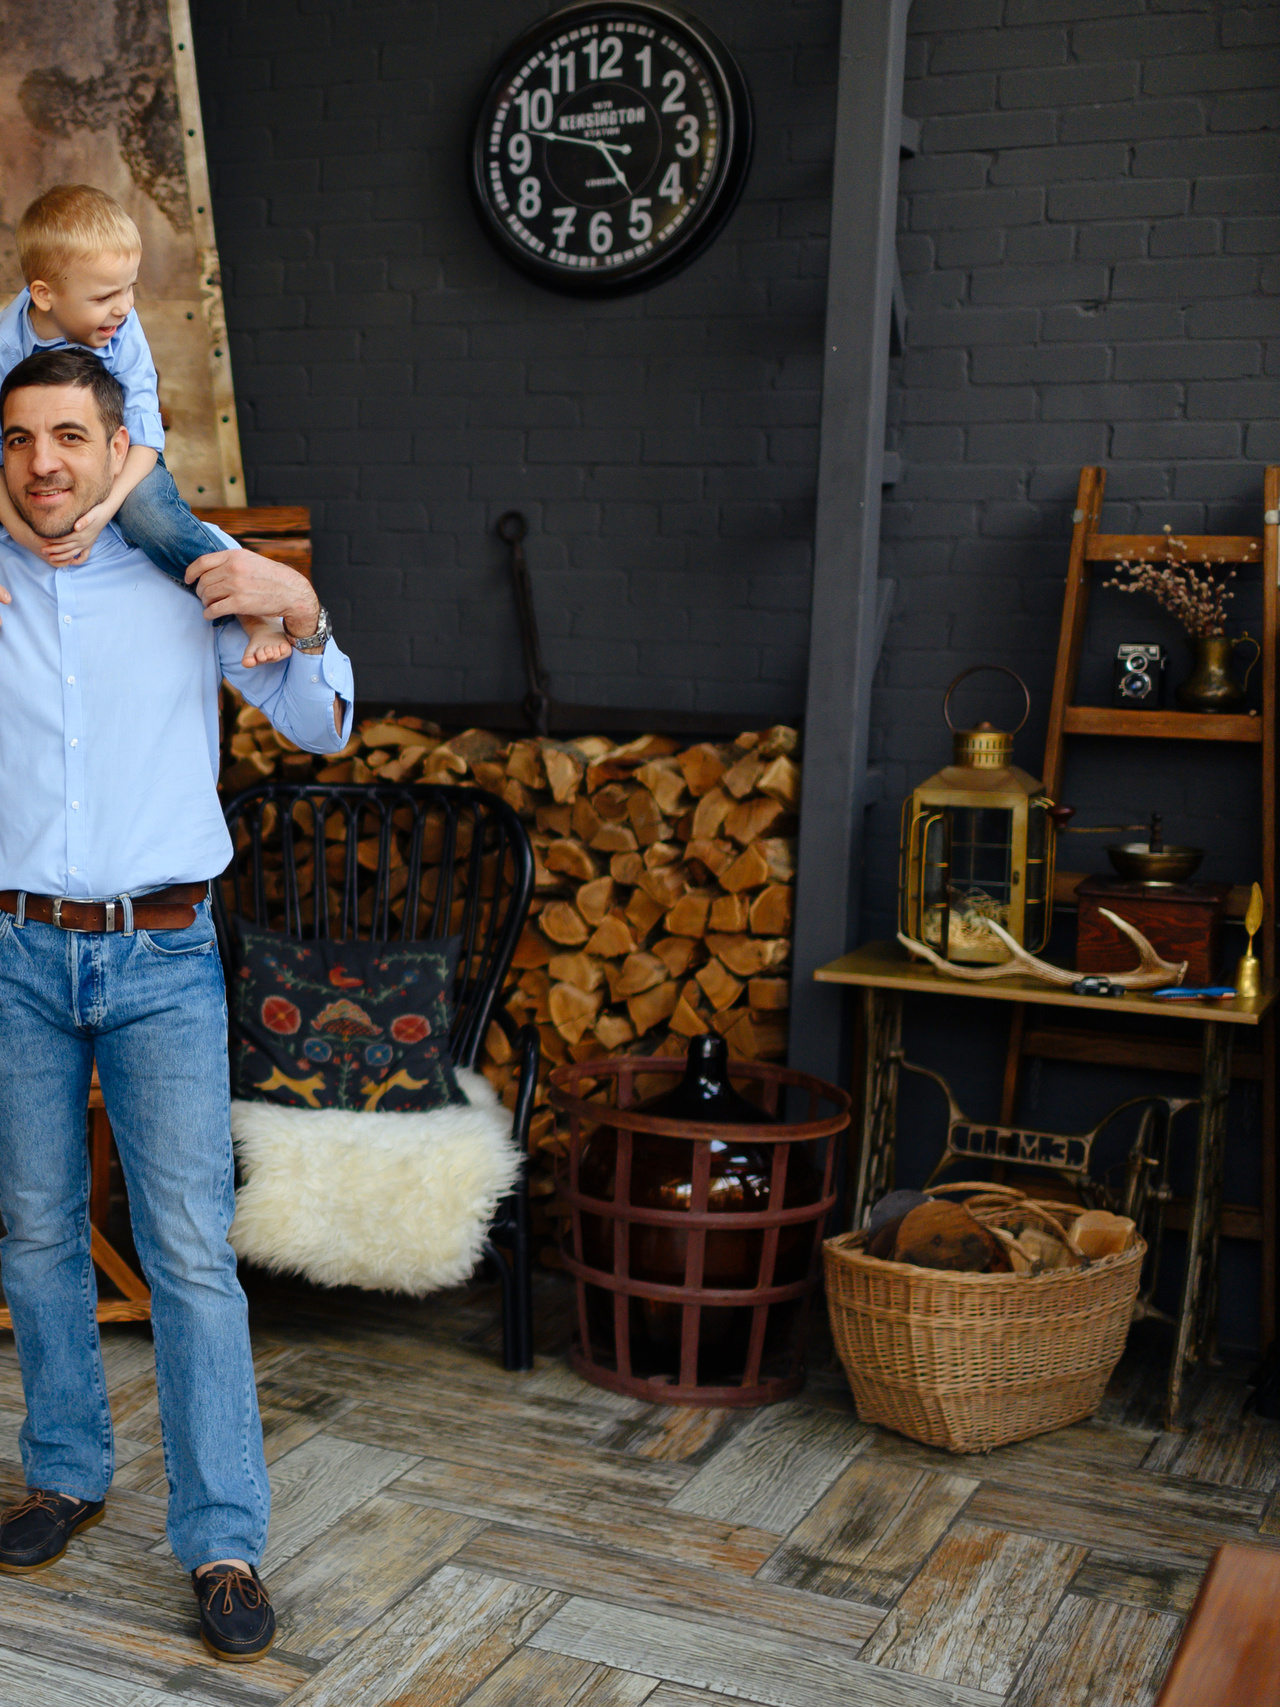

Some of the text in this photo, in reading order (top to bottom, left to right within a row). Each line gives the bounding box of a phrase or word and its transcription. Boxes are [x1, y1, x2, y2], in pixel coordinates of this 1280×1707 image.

[544, 51, 576, 95] 11
[582, 36, 624, 81] 12
[634, 45, 652, 88] 1
[513, 88, 554, 131] 10
[661, 69, 686, 114] 2
[559, 106, 646, 132] KENSINGTON
[674, 114, 700, 158] 3
[507, 132, 532, 176] 9
[517, 176, 542, 219] 8
[657, 161, 684, 205] 4
[551, 206, 578, 248] 7
[588, 210, 614, 255] 6
[627, 197, 653, 241] 5
